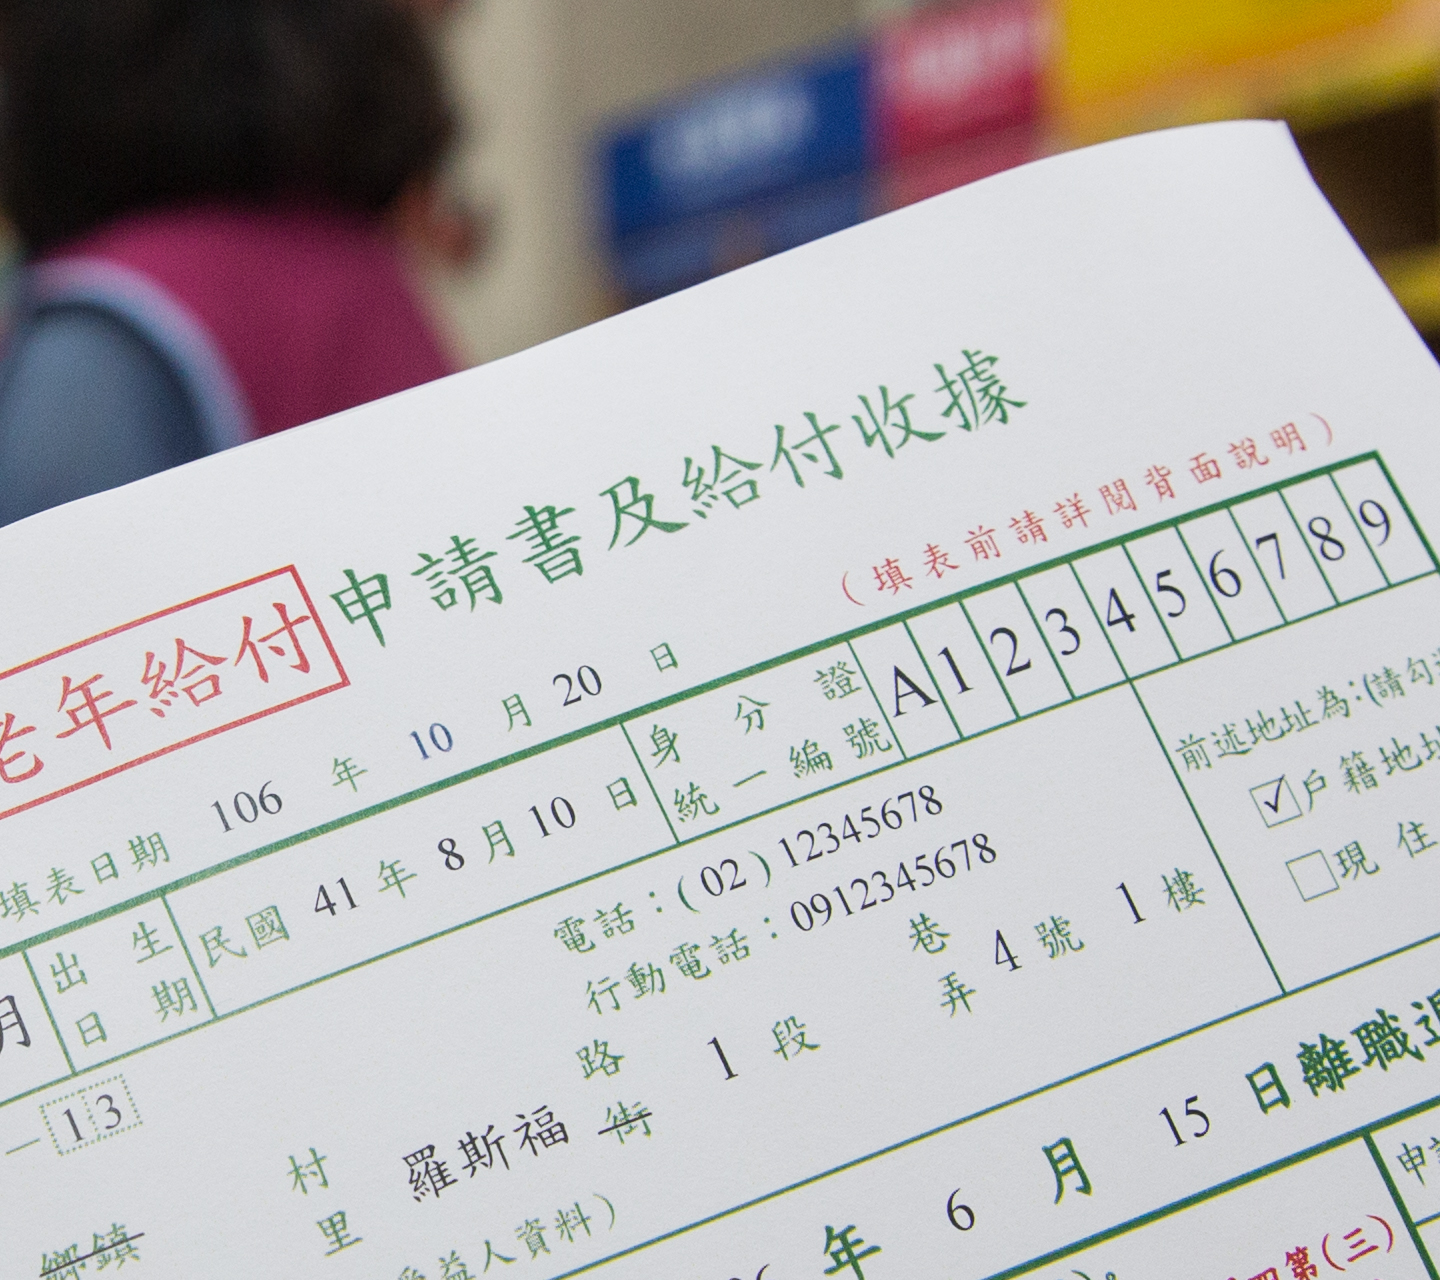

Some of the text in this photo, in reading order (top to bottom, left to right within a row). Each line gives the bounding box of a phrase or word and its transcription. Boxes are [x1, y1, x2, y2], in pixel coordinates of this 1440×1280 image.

[212, 781, 282, 832] 106
[333, 758, 367, 792] 年
[410, 723, 453, 759] 10
[502, 694, 532, 731] 月
[553, 665, 602, 706] 20
[650, 642, 678, 672] 日
[199, 777, 637, 968] 民國 41 年 8 月 10 日
[909, 912, 951, 955] 巷
[995, 868, 1205, 972] 4 號 1 樓
[939, 971, 976, 1017] 弄
[576, 1039, 625, 1080] 路
[708, 1016, 820, 1080] 1 段
[64, 1094, 121, 1142] 13
[289, 1147, 328, 1195] 村
[402, 1105, 569, 1202] 羅斯福
[947, 1188, 975, 1231] 6
[1041, 1137, 1093, 1205] 月
[1159, 1095, 1210, 1146] 15
[317, 1210, 362, 1257] 里
